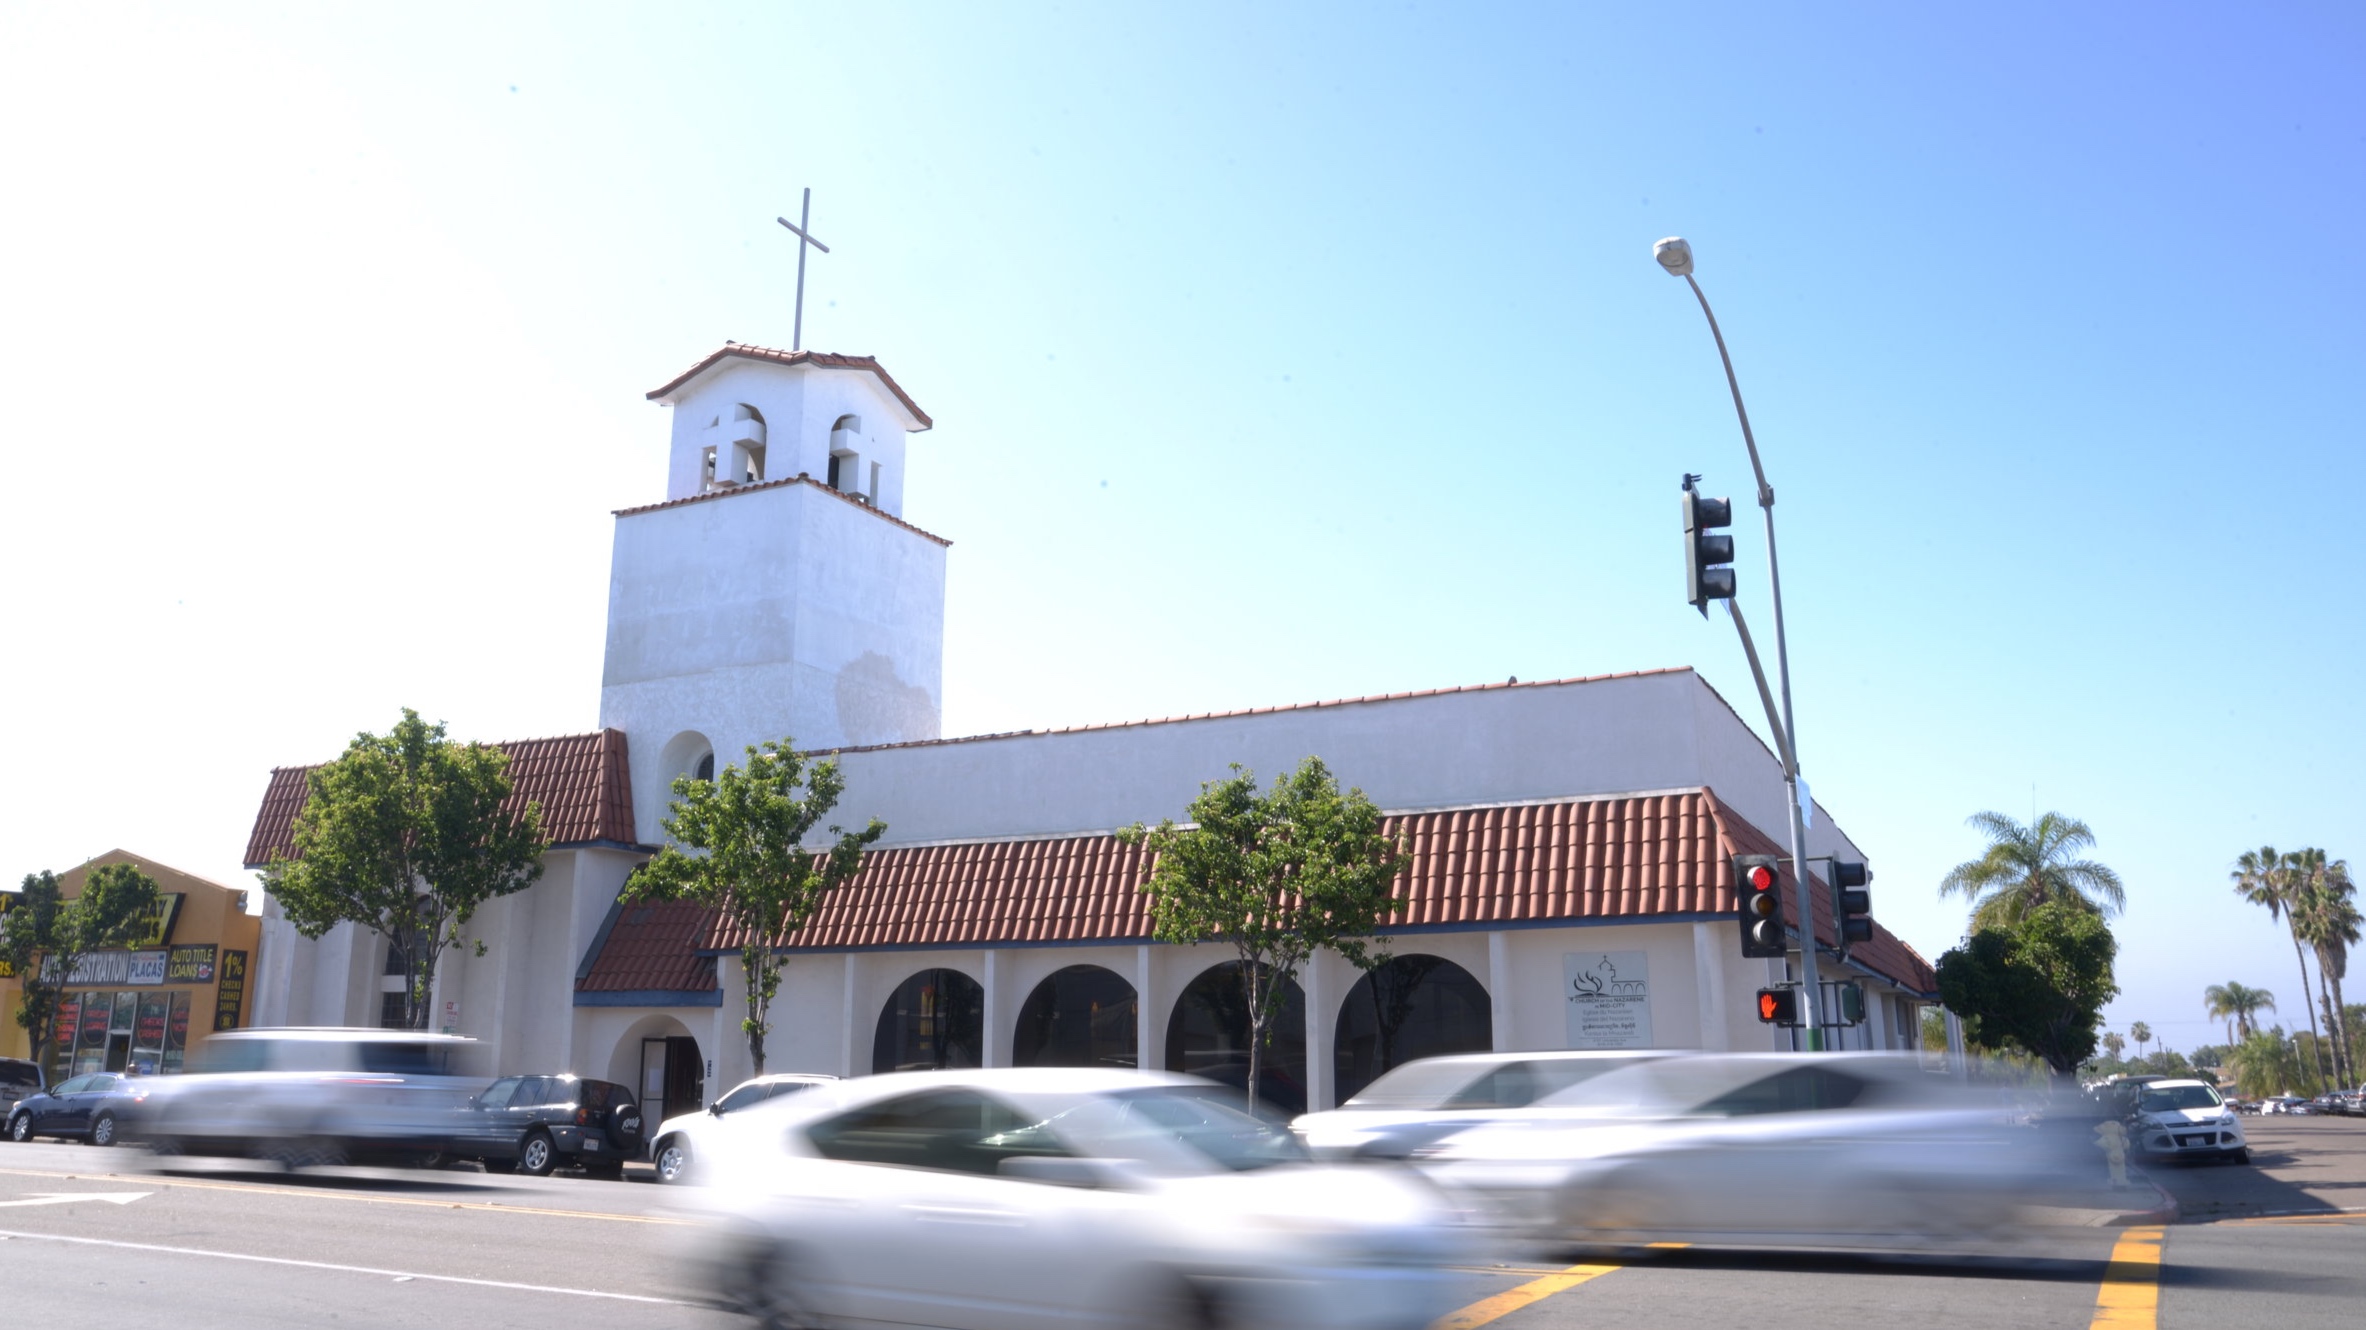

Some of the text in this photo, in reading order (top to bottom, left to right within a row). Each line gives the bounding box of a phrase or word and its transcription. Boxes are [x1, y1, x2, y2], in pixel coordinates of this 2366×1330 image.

[171, 949, 191, 962] AUTO
[191, 948, 213, 962] TITLE
[130, 962, 164, 978] PLACAS
[224, 952, 243, 978] 1%
